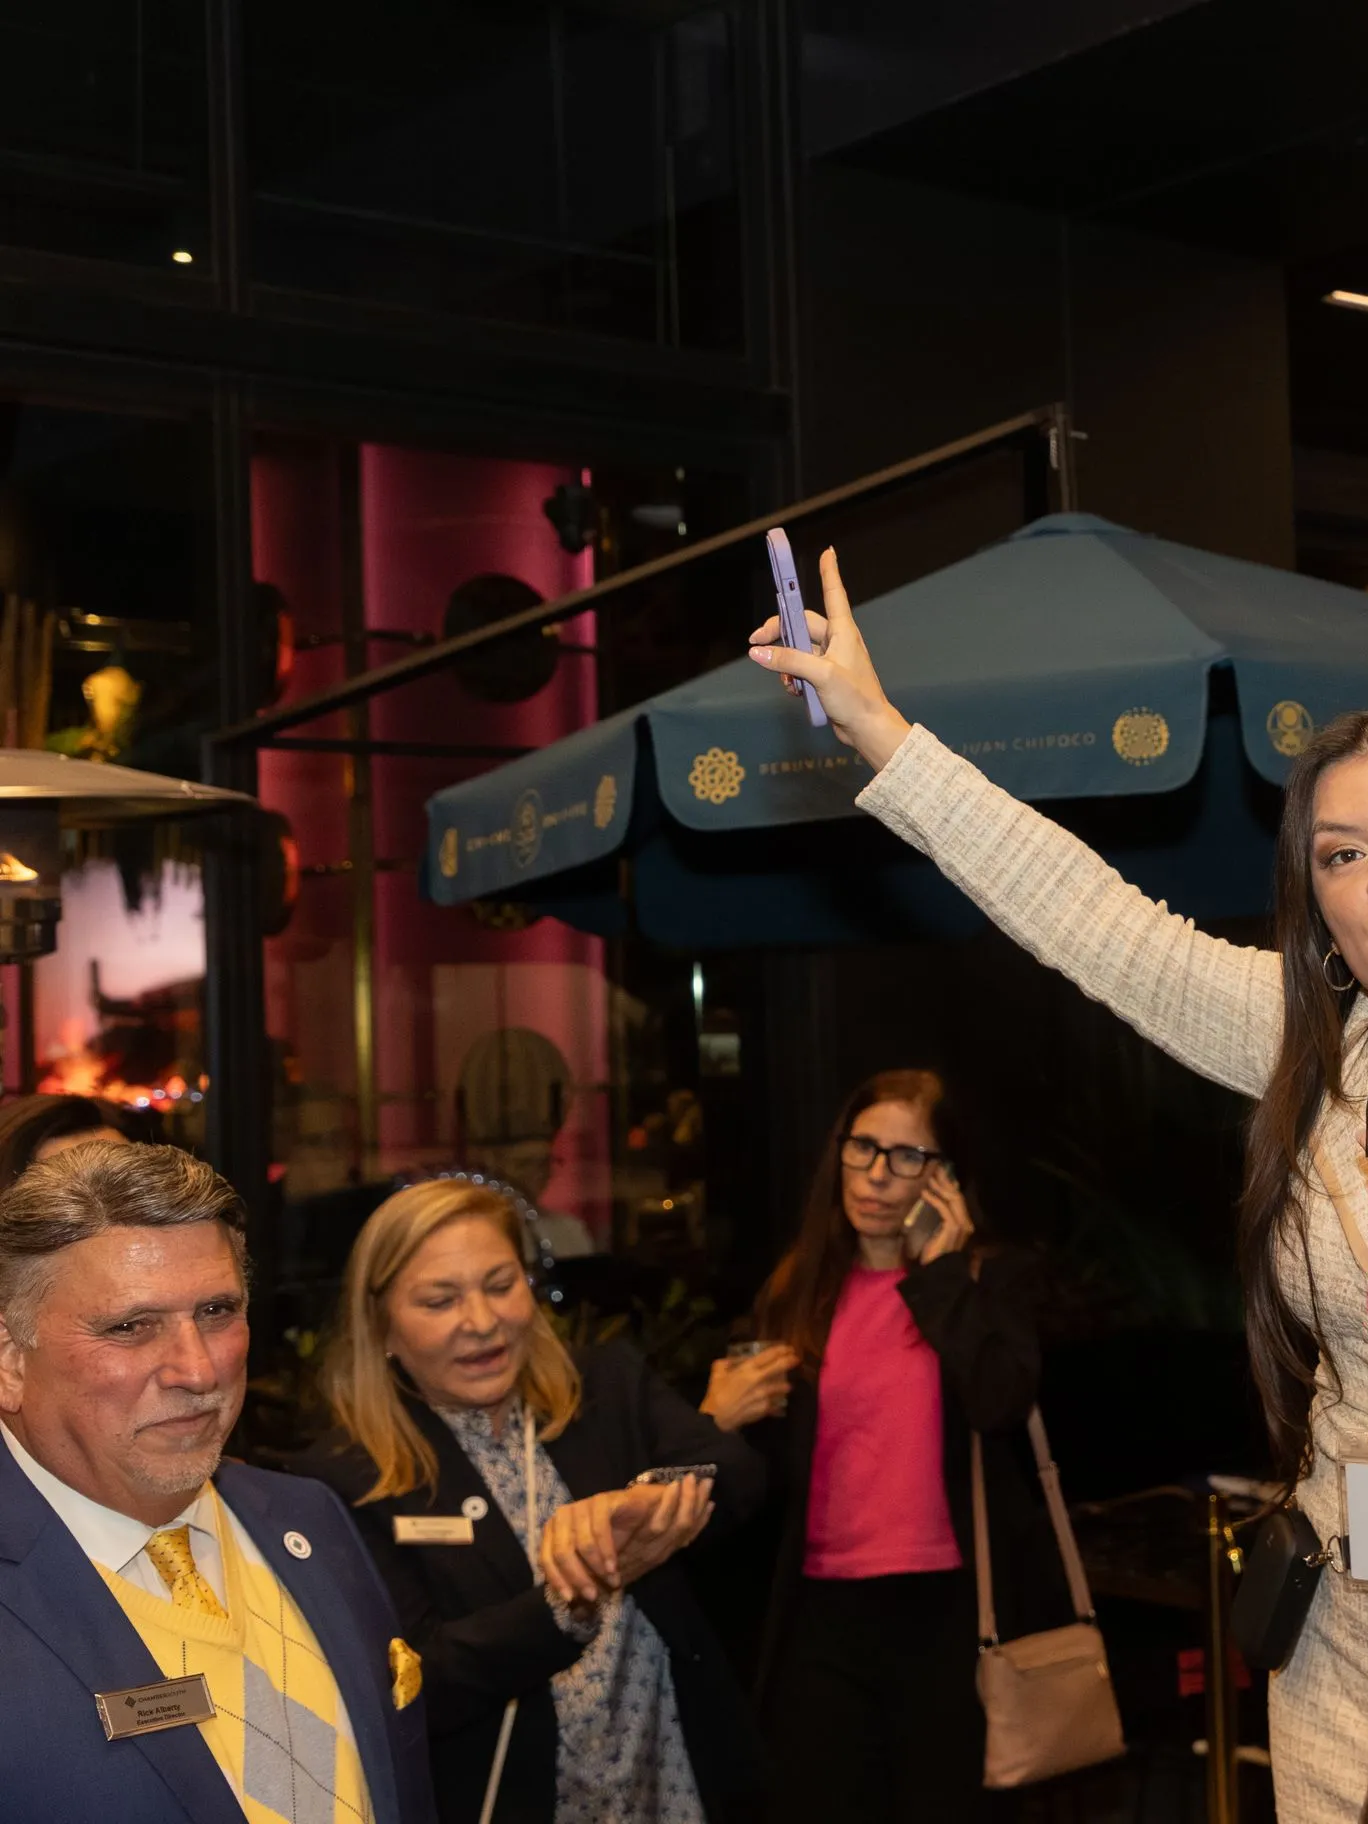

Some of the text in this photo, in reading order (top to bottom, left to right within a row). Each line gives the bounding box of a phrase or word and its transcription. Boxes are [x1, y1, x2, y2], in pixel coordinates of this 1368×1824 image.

[759, 756, 848, 775] PERUVIAN
[962, 740, 1007, 757] JUAN
[1012, 731, 1097, 751] CHIPOCO
[136, 1711, 186, 1725] Executive Director
[137, 1708, 154, 1717] Rick
